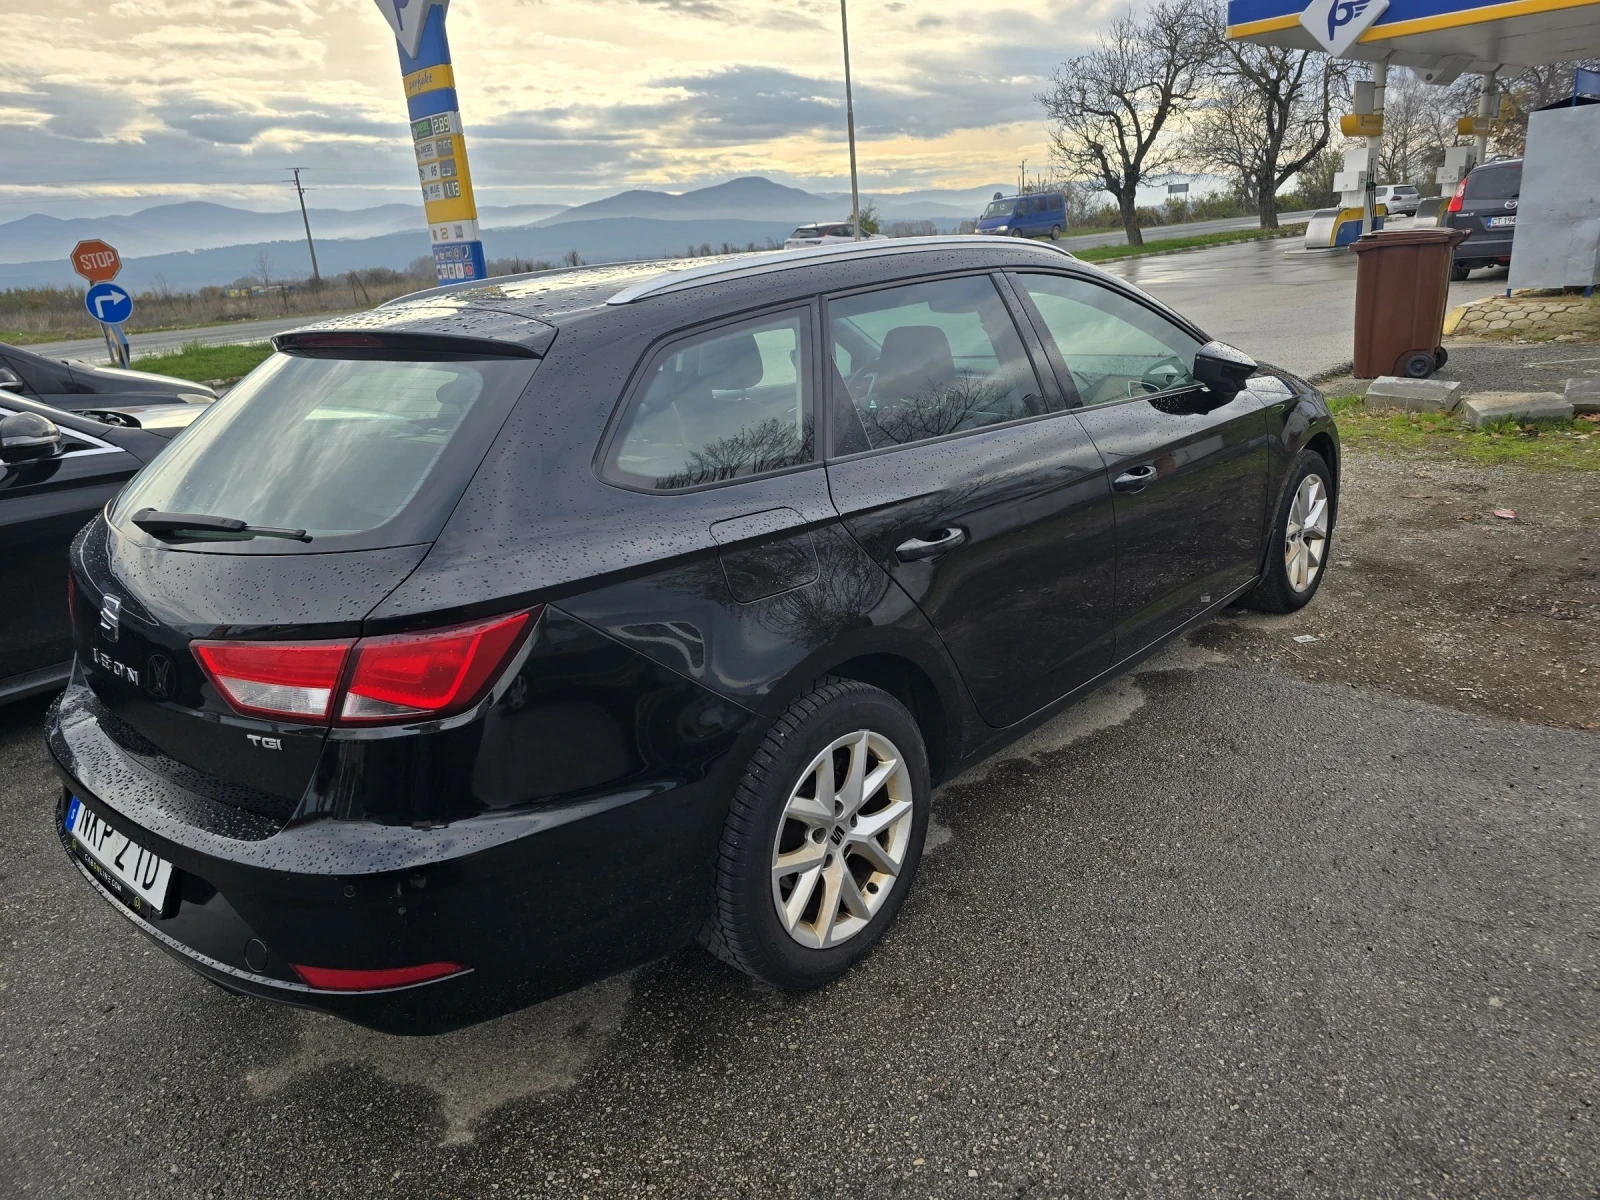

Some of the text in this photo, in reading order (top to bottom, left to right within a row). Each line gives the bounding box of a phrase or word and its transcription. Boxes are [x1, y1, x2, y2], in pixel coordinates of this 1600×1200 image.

[420, 144, 434, 154] DIESEL
[430, 165, 438, 176] 95
[80, 251, 115, 270] STOP
[93, 647, 139, 686] LEON
[246, 734, 283, 751] TGI
[70, 808, 76, 820] S
